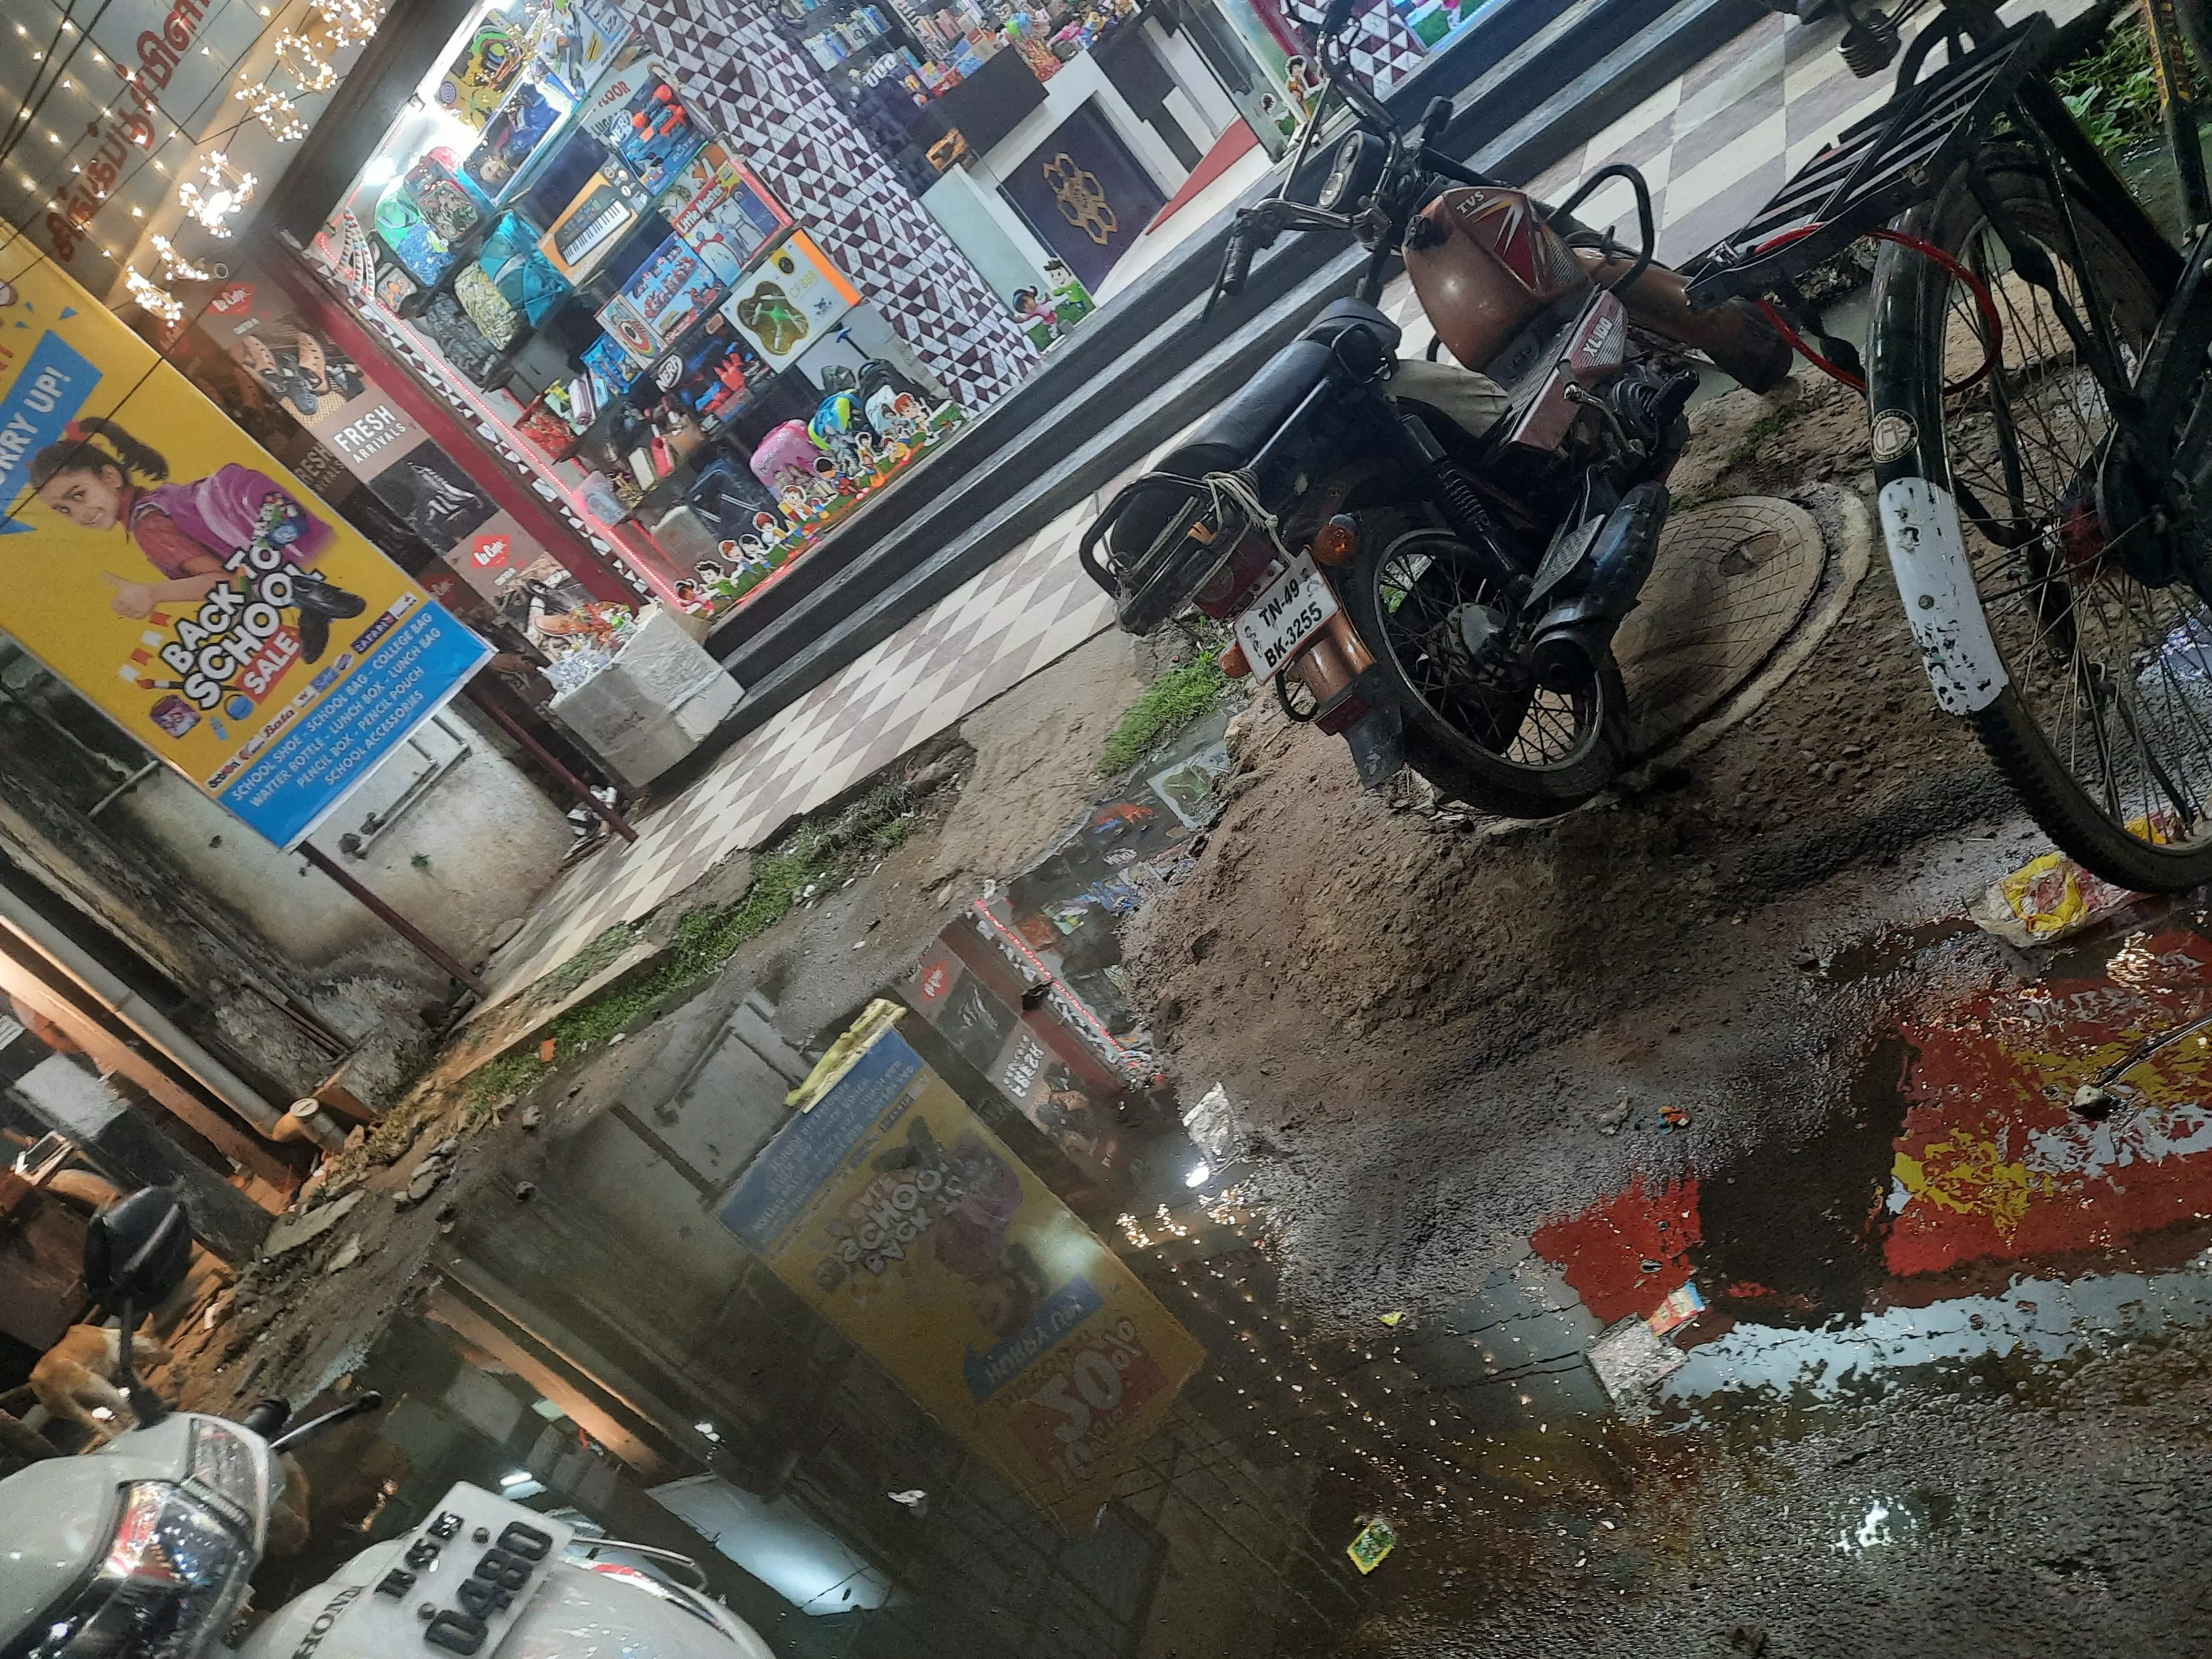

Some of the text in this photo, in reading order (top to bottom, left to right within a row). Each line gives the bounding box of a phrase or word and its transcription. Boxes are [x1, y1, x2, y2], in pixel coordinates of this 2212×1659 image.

[676, 183, 724, 234] Little Master
[1455, 191, 1485, 215] TVS
[1583, 316, 1614, 358] XL100
[655, 356, 682, 393] NERF
[0, 366, 72, 482] RRY UP!
[332, 403, 397, 453] FRESH
[351, 420, 407, 465] ARRIVALS
[159, 542, 283, 674] BACK TO
[182, 564, 326, 709] SCHOOL
[354, 619, 389, 653] SAFARI
[1259, 578, 1300, 629] TN-49
[1264, 601, 1323, 669] BK-3255
[242, 630, 301, 697] SALE
[231, 757, 277, 802] SCHOOL
[272, 733, 302, 764] SHOE
[305, 691, 348, 733] SCHOOL
[345, 671, 369, 696] BAG
[371, 629, 414, 671] COLLEGE
[409, 610, 434, 635] BAG
[249, 768, 291, 808] WATTER
[287, 736, 325, 773] BOTTLE
[328, 700, 364, 735] LUNCH
[360, 680, 385, 705] BOX
[387, 645, 422, 680] LUNCH
[419, 627, 442, 650] BAG
[261, 706, 295, 739] Bata
[296, 752, 333, 788] PENCIL
[330, 732, 354, 757] BOX
[356, 695, 394, 731] PENCIL
[389, 665, 425, 701] POUCH
[323, 744, 367, 786] SCHOOL
[362, 688, 425, 749] ACCESSORIES
[292, 1585, 363, 1659] HOND
[424, 1521, 552, 1656] 0480
